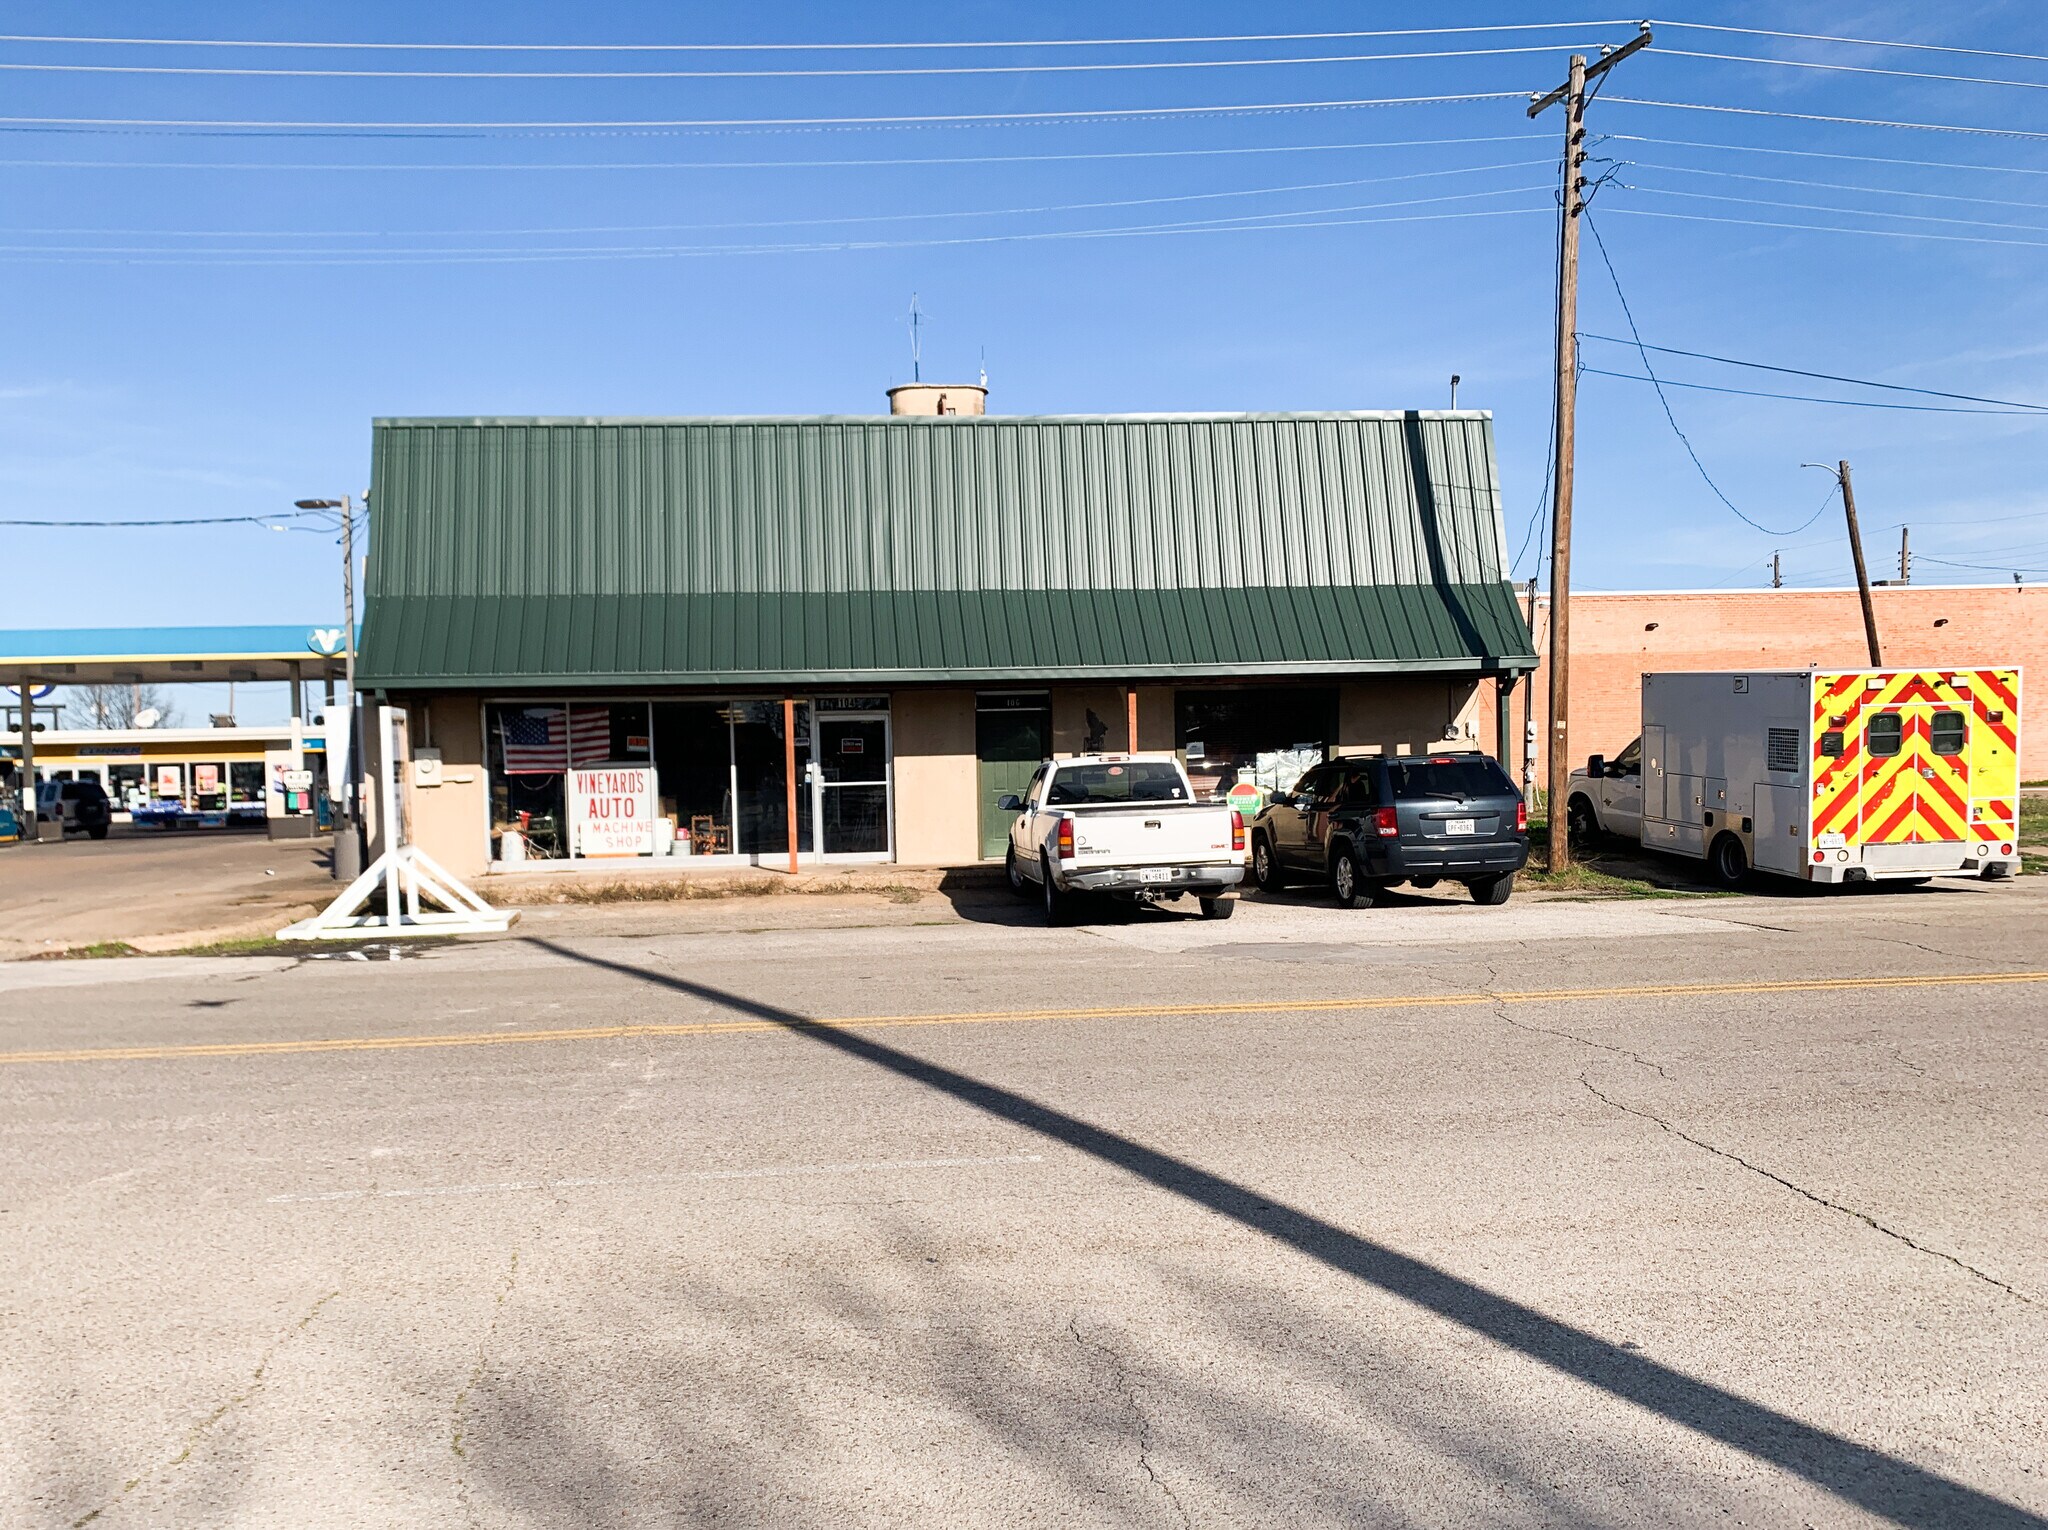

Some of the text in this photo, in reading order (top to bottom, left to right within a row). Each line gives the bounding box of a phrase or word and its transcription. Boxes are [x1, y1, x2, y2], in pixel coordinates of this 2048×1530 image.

[577, 769, 644, 794] VINEYARD'S
[588, 797, 634, 819] AUTO
[592, 821, 653, 834] MACHINE
[606, 836, 642, 848] SHOP
